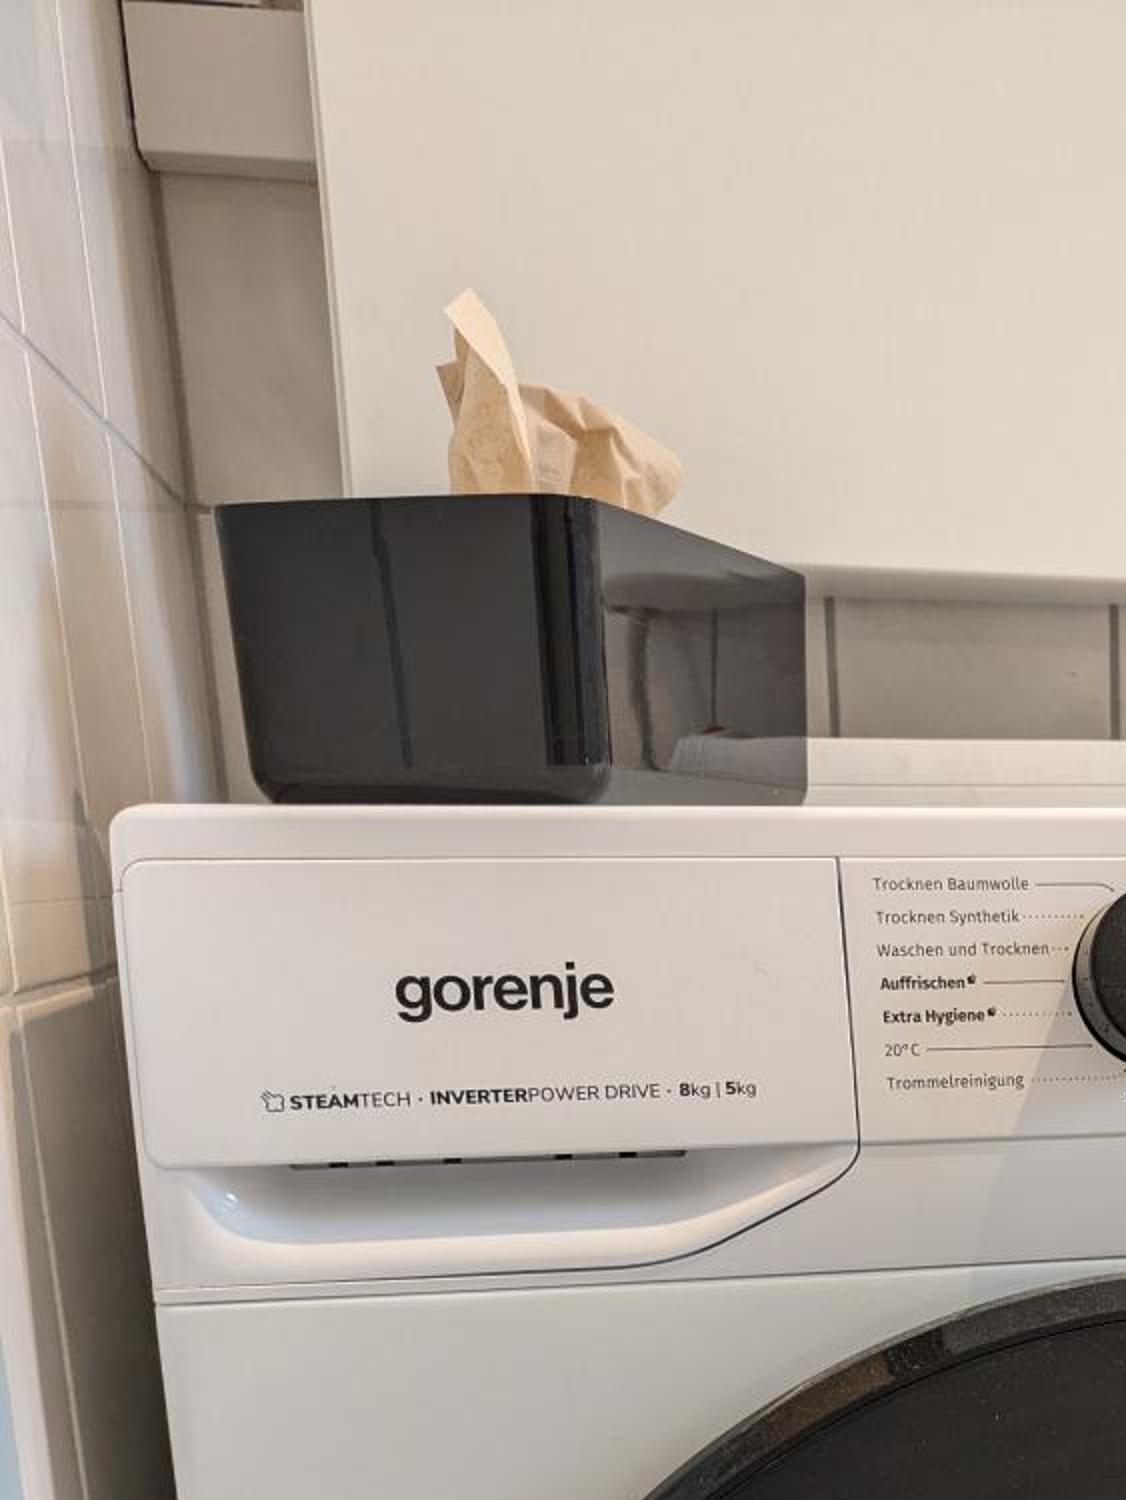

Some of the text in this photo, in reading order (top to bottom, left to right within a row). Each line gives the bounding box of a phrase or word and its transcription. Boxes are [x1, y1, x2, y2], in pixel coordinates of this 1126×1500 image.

[873, 877, 1029, 891] Trocknen Baumwolle
[876, 909, 1020, 926] Trocknen Synthetik
[876, 942, 1049, 957] Waschen und Trocknen
[880, 975, 966, 991] Auffrischen
[395, 962, 614, 1023] gorenje
[883, 1008, 985, 1026] Extra Hygiene
[887, 1074, 1025, 1090] Trommelreinigung
[290, 1081, 757, 1111] STEAMTECH INVERTERPOWER DRIVE 8kg 5kg
